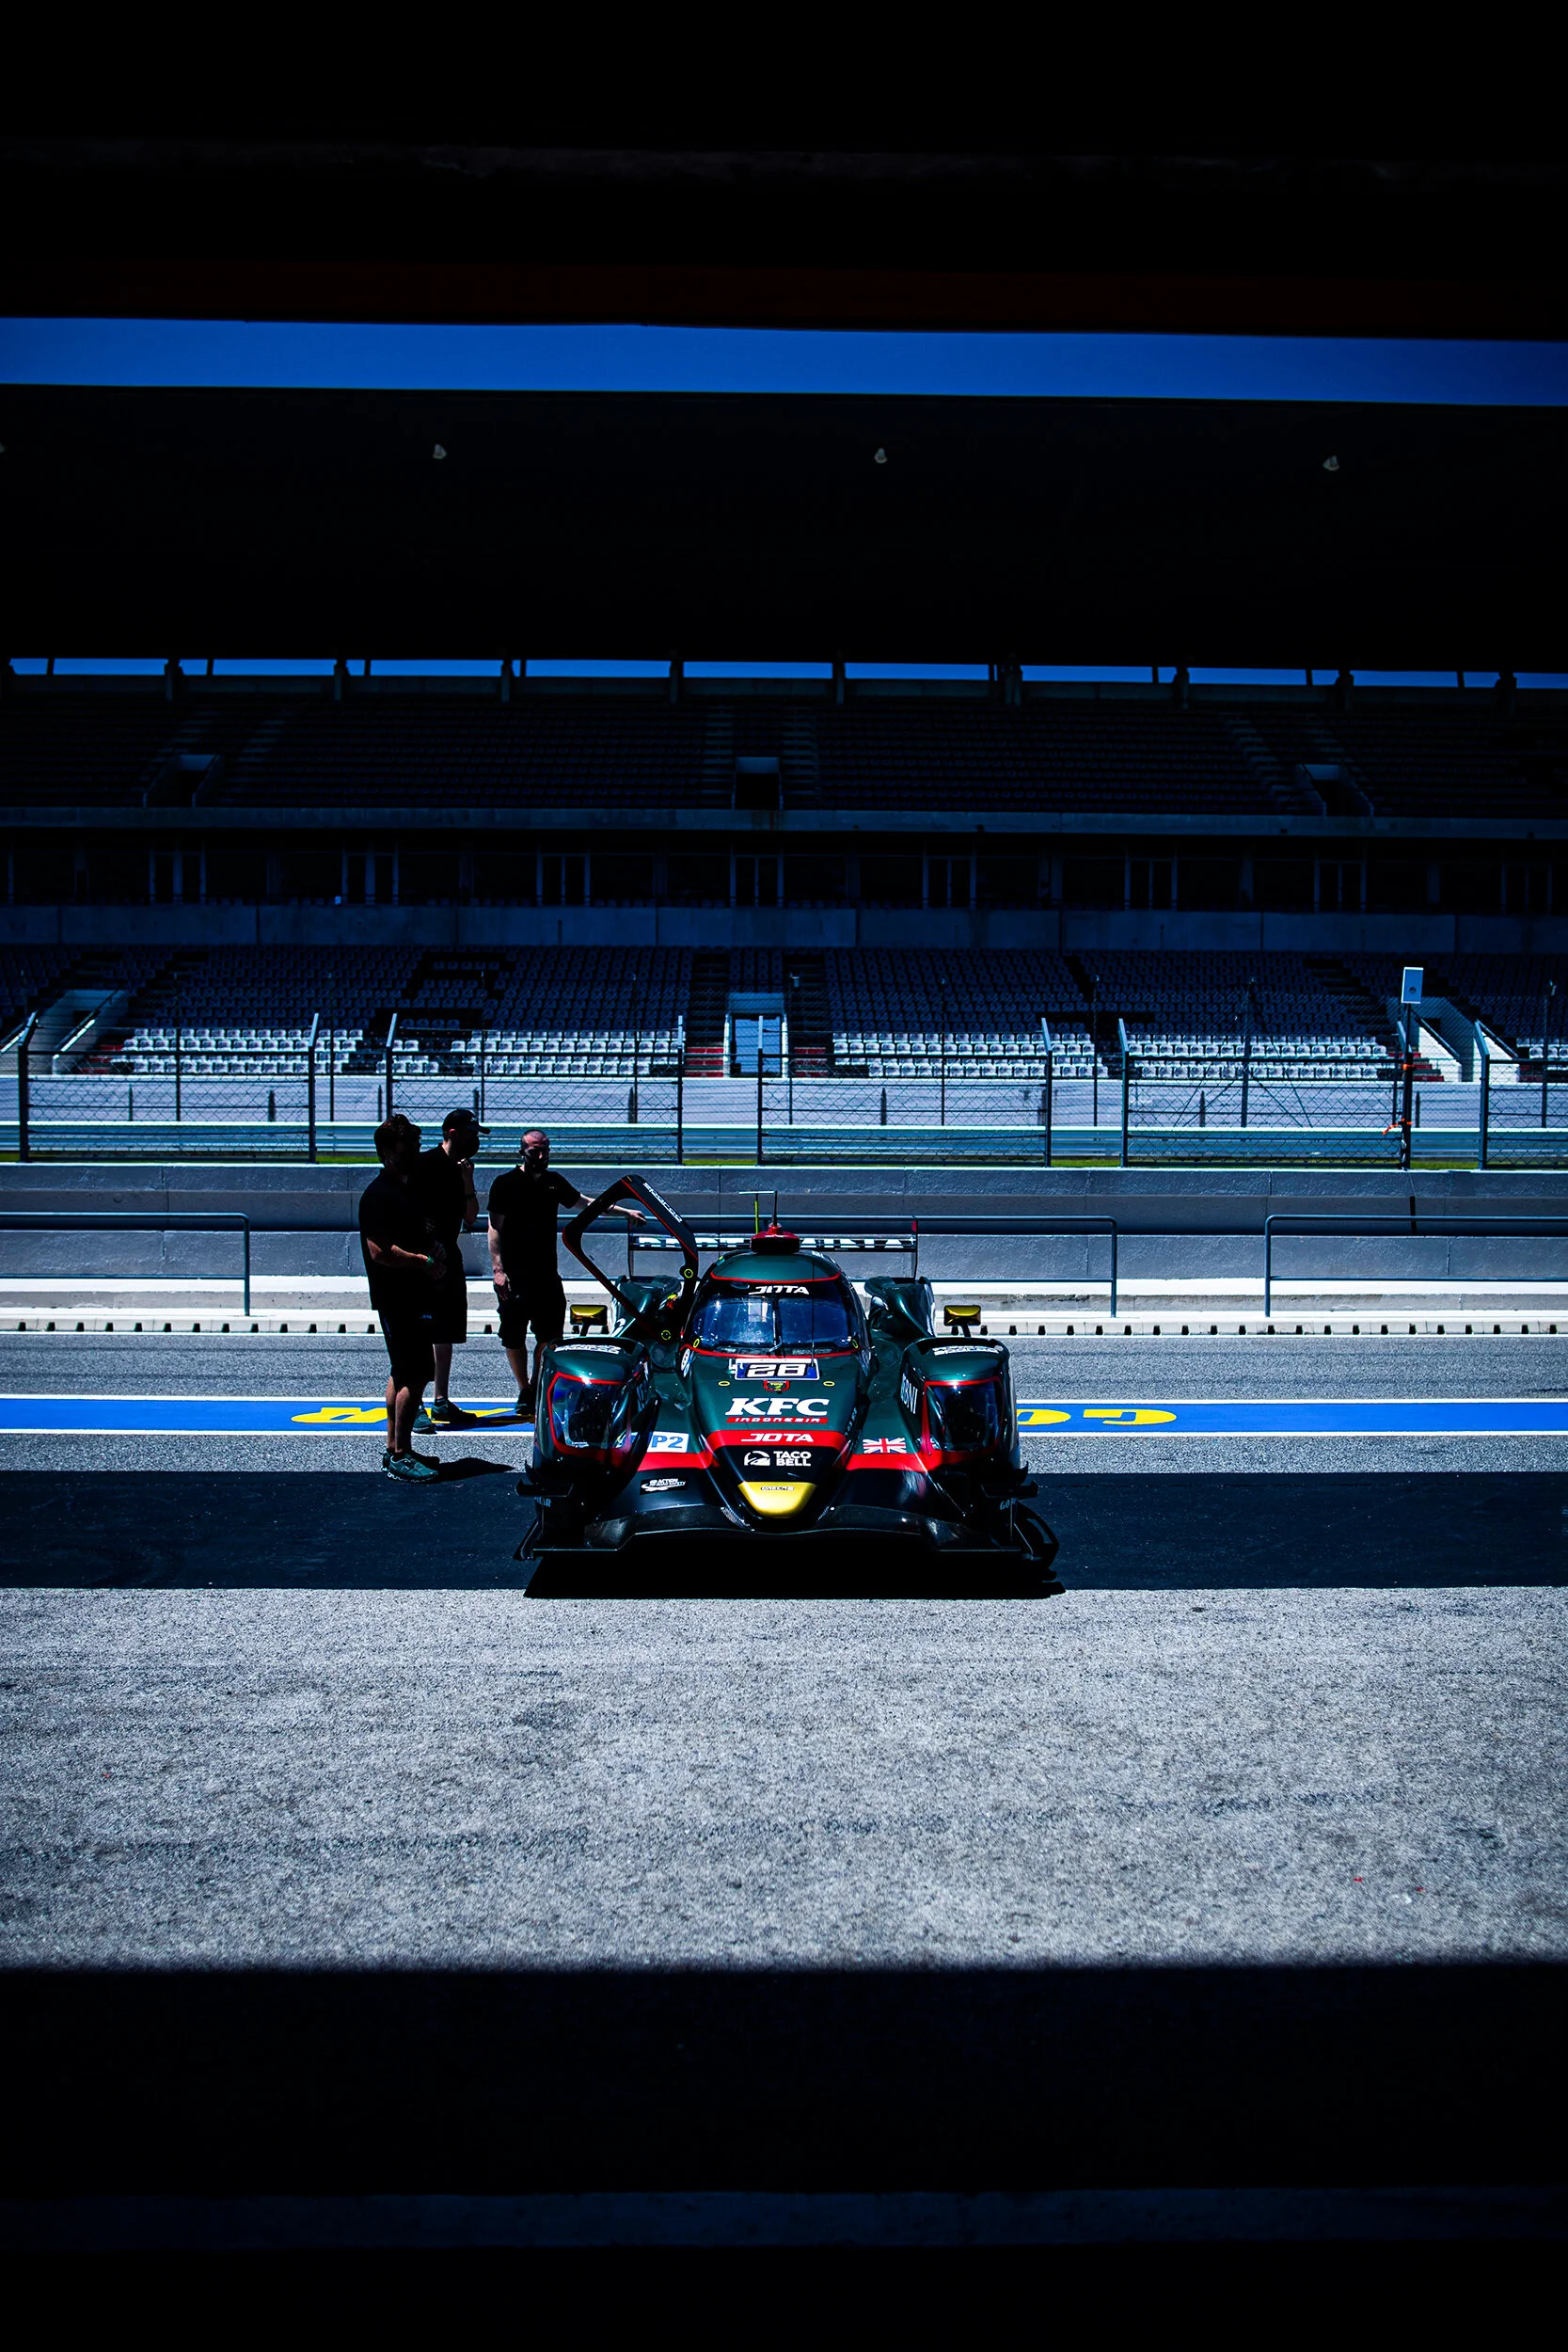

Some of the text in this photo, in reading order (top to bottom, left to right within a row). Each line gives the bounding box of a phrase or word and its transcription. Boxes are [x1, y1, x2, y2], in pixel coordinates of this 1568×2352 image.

[746, 1363, 807, 1378] 28
[725, 1397, 830, 1416] KFC
[740, 1433, 815, 1442] JOTA
[773, 1451, 812, 1459] TACO
[775, 1458, 812, 1467] BELL
